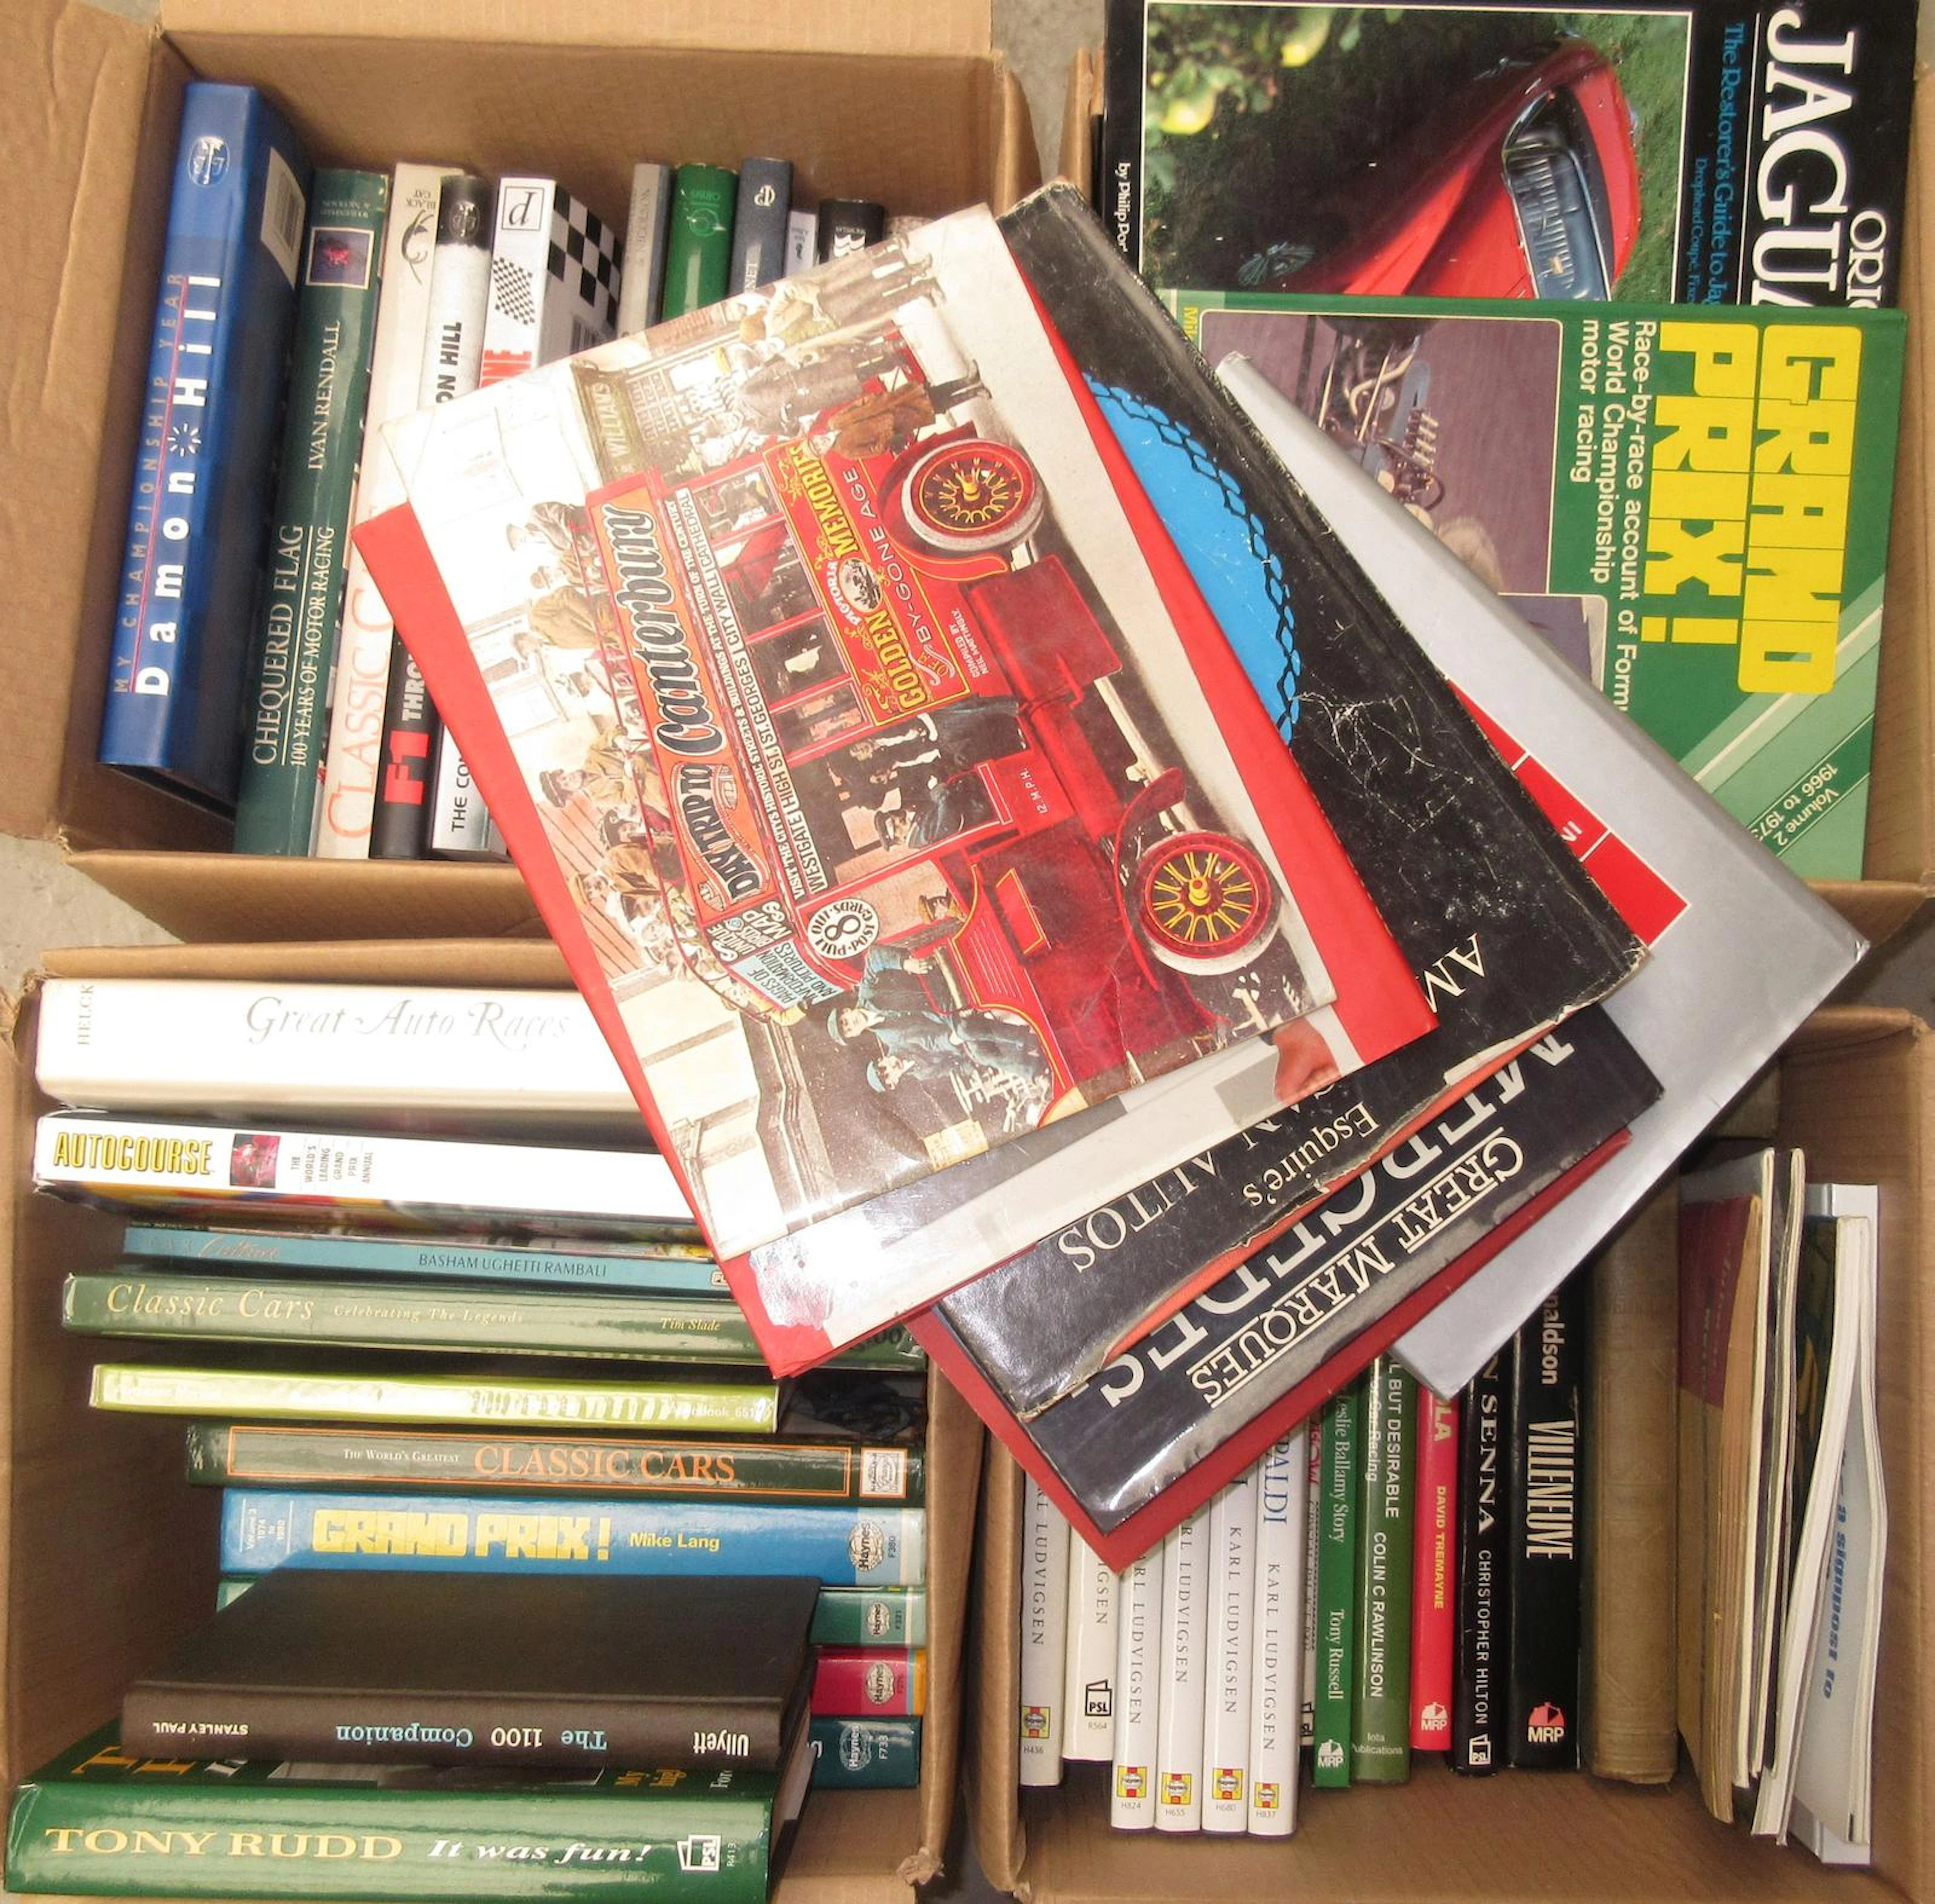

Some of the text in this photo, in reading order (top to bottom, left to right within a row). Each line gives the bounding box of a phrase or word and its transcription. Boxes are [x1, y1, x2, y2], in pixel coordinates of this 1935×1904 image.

[1710, 24, 1745, 272] The Restorer's Guide to
[1114, 162, 1132, 222] by Phillip
[1692, 157, 1707, 222] Drophead
[440, 322, 462, 366] HILL
[308, 321, 341, 471] IVAN RENDALL
[1570, 320, 1599, 484] motor racing
[1626, 321, 1656, 490] Race-by-race
[1590, 321, 1628, 584] World Championship
[115, 274, 183, 693] MY CHAMPIONSHIP YEAR
[135, 276, 222, 696] Damon Hill
[1640, 321, 1862, 693] GRAND PRIX!
[686, 570, 700, 585] OF
[842, 466, 932, 644] BY-GONE AGE
[1620, 499, 1642, 600] account
[690, 584, 710, 614] TURN
[700, 614, 717, 636] THE
[1618, 609, 1637, 634] of
[252, 525, 303, 766] CHEQUERED FLAG
[291, 526, 335, 766] 100 YEARS OF MOTOR RACING
[603, 504, 724, 755] Canterbury
[954, 634, 981, 678] COMPILED
[714, 650, 741, 708] BUILDINGS
[868, 609, 928, 709] GOLDEN
[676, 491, 825, 892] WESTGATE HIGH GEORGES CITY WALL CATHEDRAL
[329, 645, 391, 837] CLASSIC
[384, 730, 431, 804] F1
[734, 718, 759, 765] STREETS
[451, 795, 467, 833] THE
[748, 763, 776, 813] HISTORIC
[1784, 763, 1838, 810] 1966 to
[681, 798, 732, 852] TRIP
[1776, 788, 1838, 846] Volume 2
[775, 842, 794, 867] THE
[782, 863, 804, 900] VISIT
[706, 923, 755, 956] UNIQUE
[741, 907, 792, 939] MAP
[78, 984, 94, 1045] HELCK
[246, 996, 571, 1051] Great Auto Races
[53, 1132, 213, 1175] AUTOCOURSE
[1243, 1102, 1380, 1205] Esquire's
[419, 1253, 606, 1277] BASHAM UGHETTI RAMBALI
[1190, 1134, 1523, 1403] GREAT MARQUES
[107, 1283, 721, 1331] Classic Cars Celebrating The Legends Tim Slade
[365, 1449, 410, 1463] WORLD'S
[412, 1450, 461, 1464] GREATEST
[475, 1446, 631, 1477] CLASSIC
[640, 1450, 736, 1483] CARS
[1386, 1380, 1402, 1518] BUT DESIRABLE
[1526, 1419, 1575, 1559] VILLENEUVE
[312, 1510, 720, 1561] GRAND PRIX! Mike Lang
[858, 1522, 870, 1569] Haynes
[1434, 1486, 1446, 1609] DAVID TREMAYNE
[1475, 1394, 1498, 1724] SENNA CHRISTOPHER HILTON
[1031, 1523, 1049, 1646] LUDVIGSEN
[1327, 1441, 1349, 1699] Ballamy Story Tony Russell
[1176, 1562, 1192, 1684] LUDVIGSEN
[1225, 1527, 1242, 1713] KARL LUDVIGSEN
[1370, 1532, 1385, 1697] COLIN C RAWLINSON
[875, 1664, 884, 1703] Haynes
[1130, 1602, 1145, 1724] LUDVIGSEN
[1263, 1564, 1279, 1751] KARL LUDVIGSEN
[1089, 1701, 1108, 1712] PSL
[1422, 1720, 1447, 1731] MRP
[1528, 1728, 1565, 1742] MRP
[153, 1723, 750, 1756] Ullyett The 1100 Companion STANLEY PAUL
[849, 1725, 859, 1767] Haynes
[879, 1735, 888, 1760] F733
[1318, 1756, 1343, 1767] MRP
[45, 1828, 652, 1864] TONY RUDD It was fun!
[701, 1841, 715, 1866] PSL
[727, 1843, 736, 1867] R413
